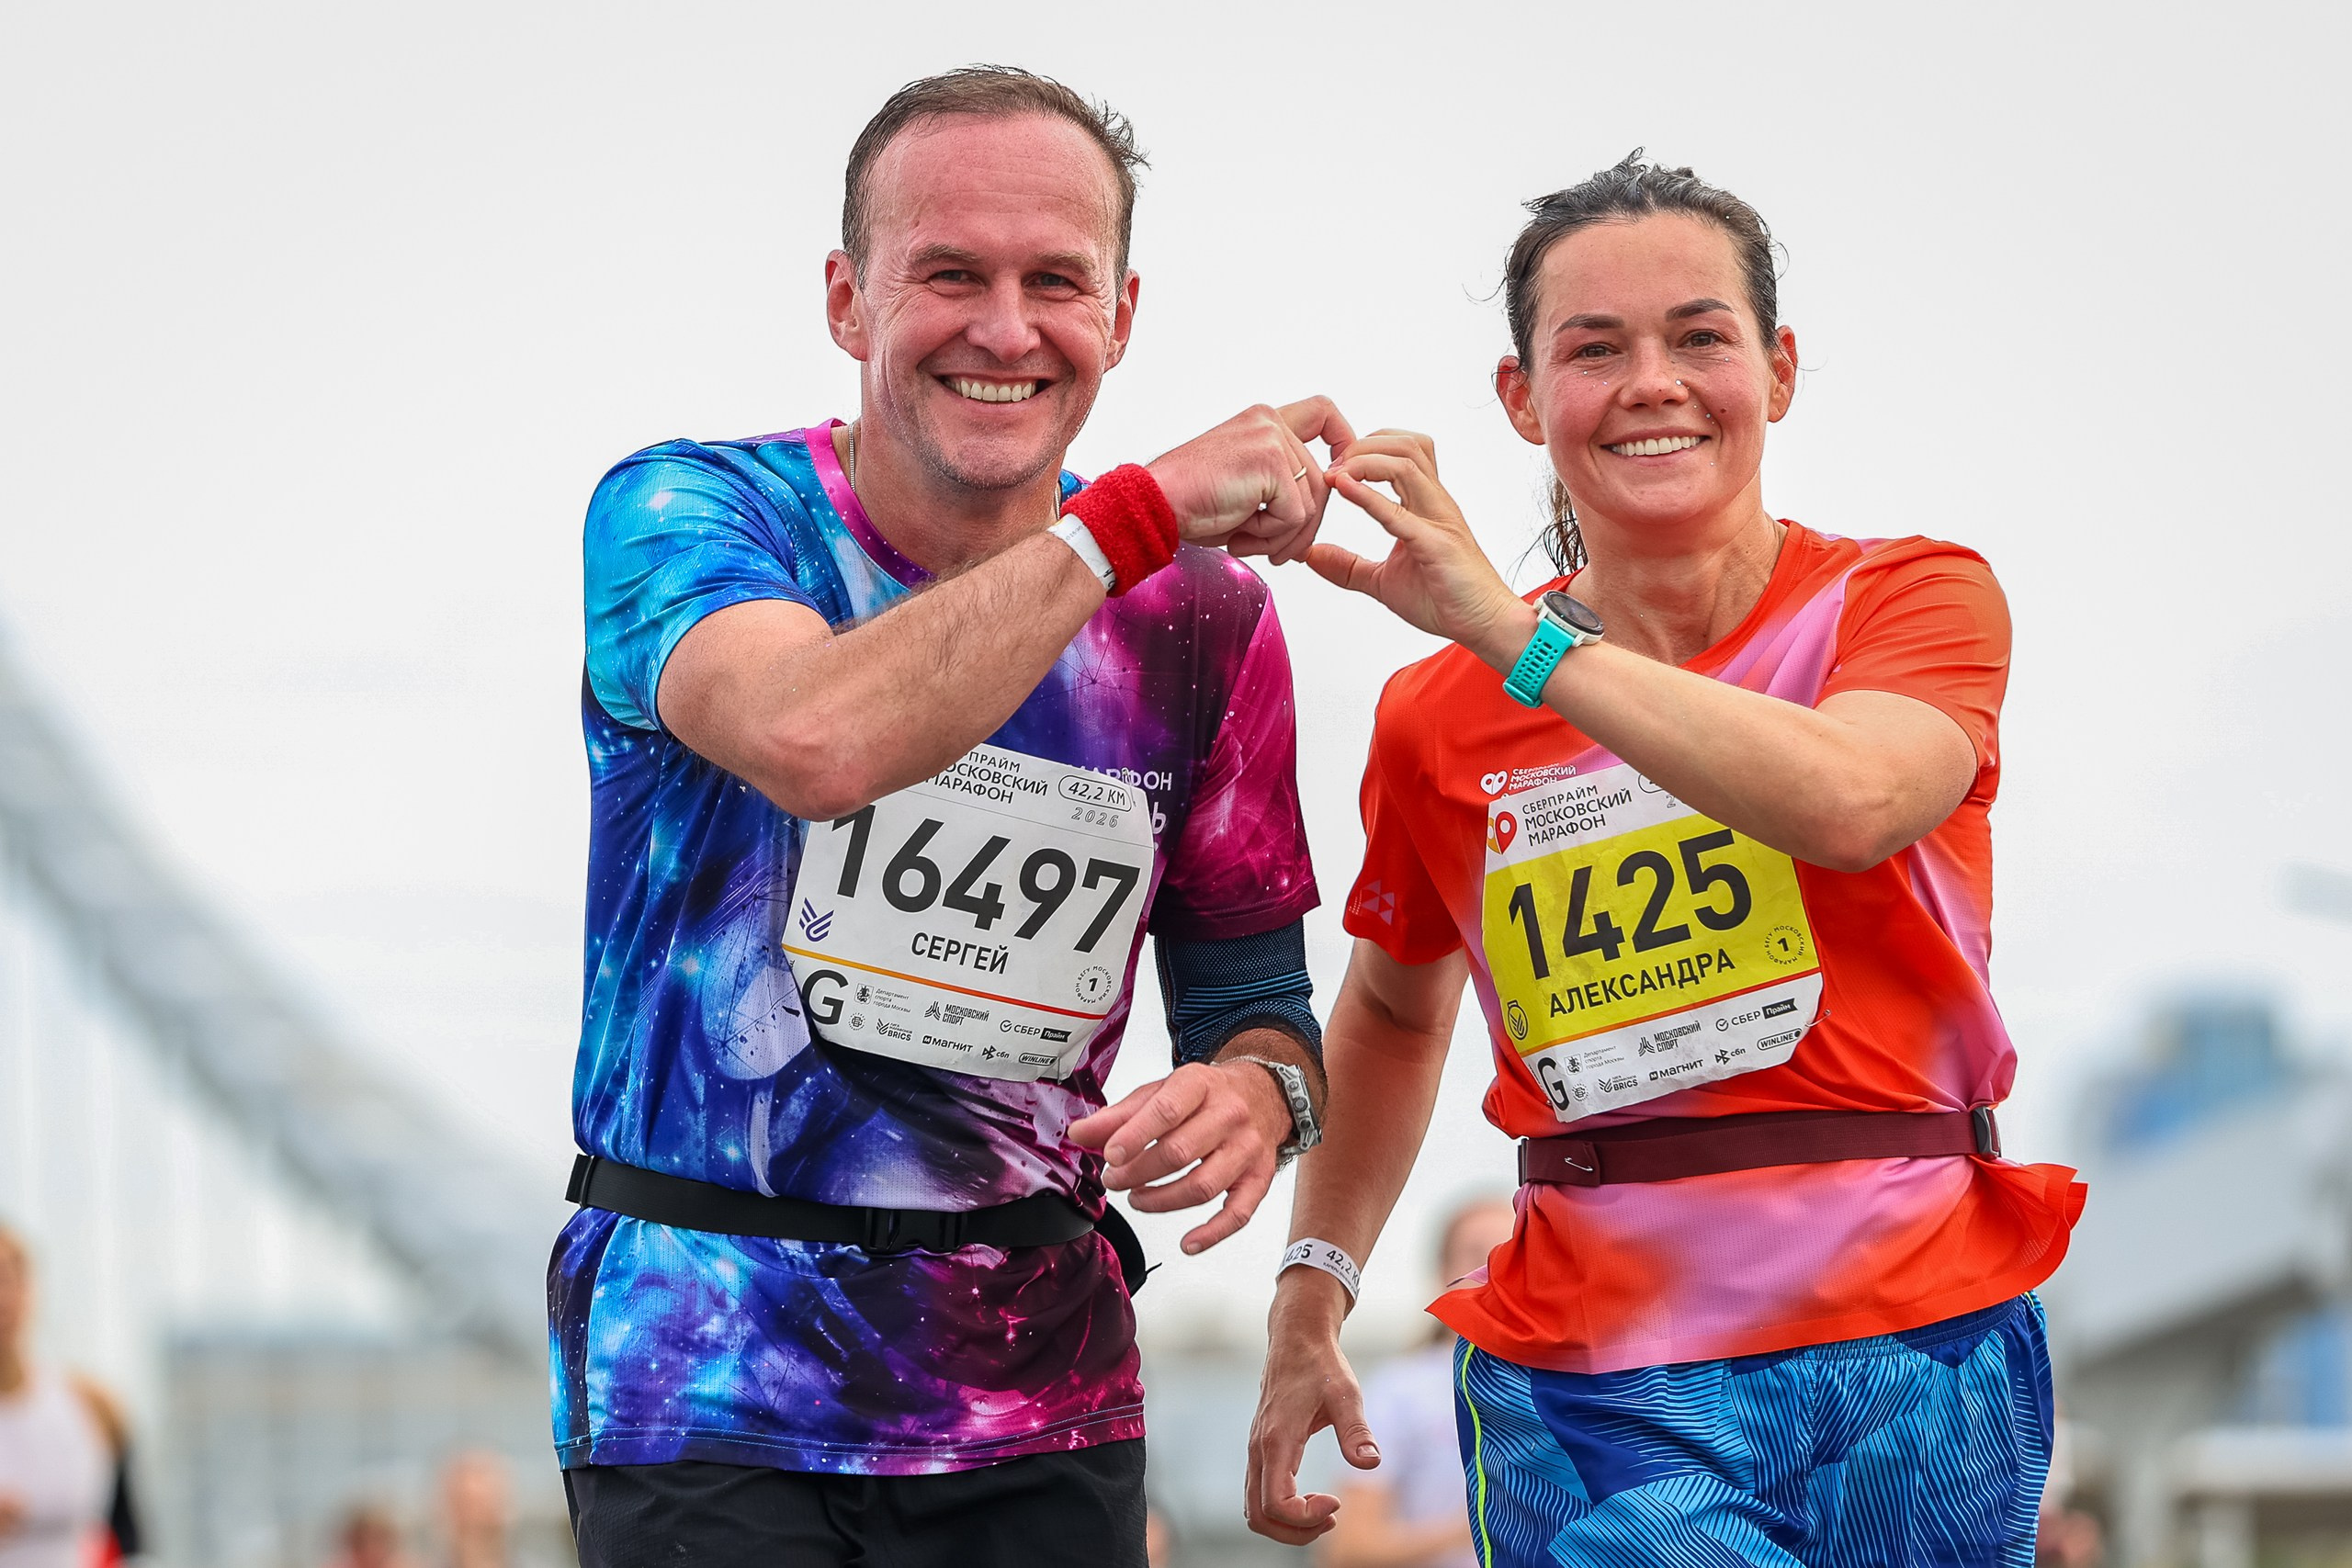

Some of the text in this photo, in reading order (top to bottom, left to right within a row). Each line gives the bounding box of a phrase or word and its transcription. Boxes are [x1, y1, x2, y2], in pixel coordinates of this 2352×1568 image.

[968, 751, 1020, 773] ПРАЙМ
[944, 762, 1048, 796] СКОВСКИЙ
[1509, 776, 1557, 791] МАРАФОН
[1510, 765, 1577, 784] МОСКОВСКИЙ
[1069, 782, 1125, 806] 42,2 КМ
[1521, 784, 1598, 815] СБЕРПРАЙМ
[1070, 807, 1119, 828] 2026
[1525, 788, 1633, 830] МОСКОВСКИЙ
[1529, 814, 1606, 847] МАРАФОН
[831, 804, 1141, 953] 16497
[1508, 829, 1752, 980] 1425
[910, 932, 1009, 975] СЕРГЕЙ
[1777, 937, 1789, 952] 1
[1088, 977, 1098, 992] 1
[1549, 947, 1736, 1019] АЛЕКСАНДРА
[801, 969, 849, 1025] G
[943, 1013, 965, 1026] СПОРТ
[944, 1003, 989, 1021] МОСКОВСКИЙ
[1731, 1003, 1791, 1026] СБЕР Прайм
[888, 1030, 911, 1042] BRICS
[1013, 1024, 1066, 1040] СБЕР Прайм
[1654, 1021, 1702, 1043] МОСКОВСКИЙ
[1759, 1032, 1793, 1049] WINLINE
[1657, 1038, 1679, 1053] СПОРТ
[1021, 1055, 1050, 1064] WINLINE
[1537, 1056, 1570, 1111] G
[1613, 1078, 1638, 1091] BRICS
[1326, 1249, 1352, 1275] 42,2
